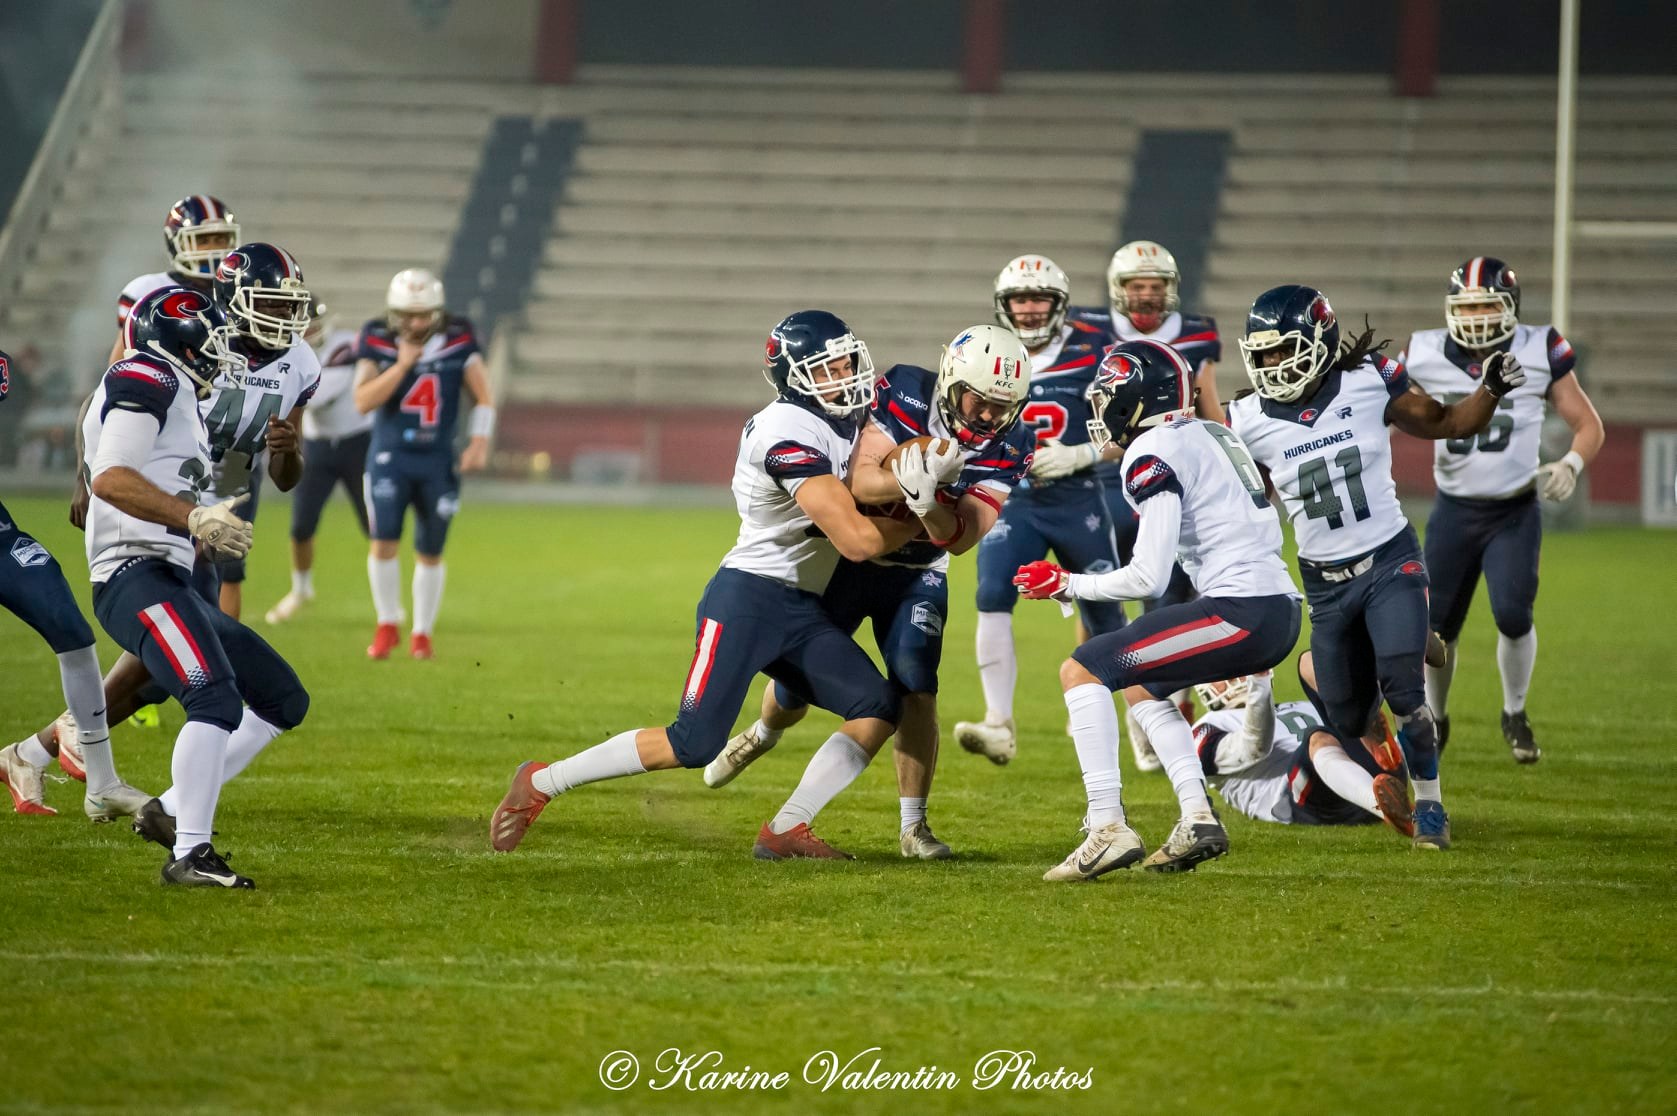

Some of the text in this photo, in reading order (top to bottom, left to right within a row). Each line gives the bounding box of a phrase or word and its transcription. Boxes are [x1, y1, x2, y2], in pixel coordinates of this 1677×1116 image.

[223, 373, 280, 390] HRRICANES
[401, 373, 440, 426] 4
[995, 380, 1013, 389] KFC
[904, 396, 929, 411] acqua
[204, 389, 284, 471] 44
[1284, 429, 1354, 460] HURRICANES
[1203, 423, 1271, 509] 6
[1298, 445, 1371, 530] 41
